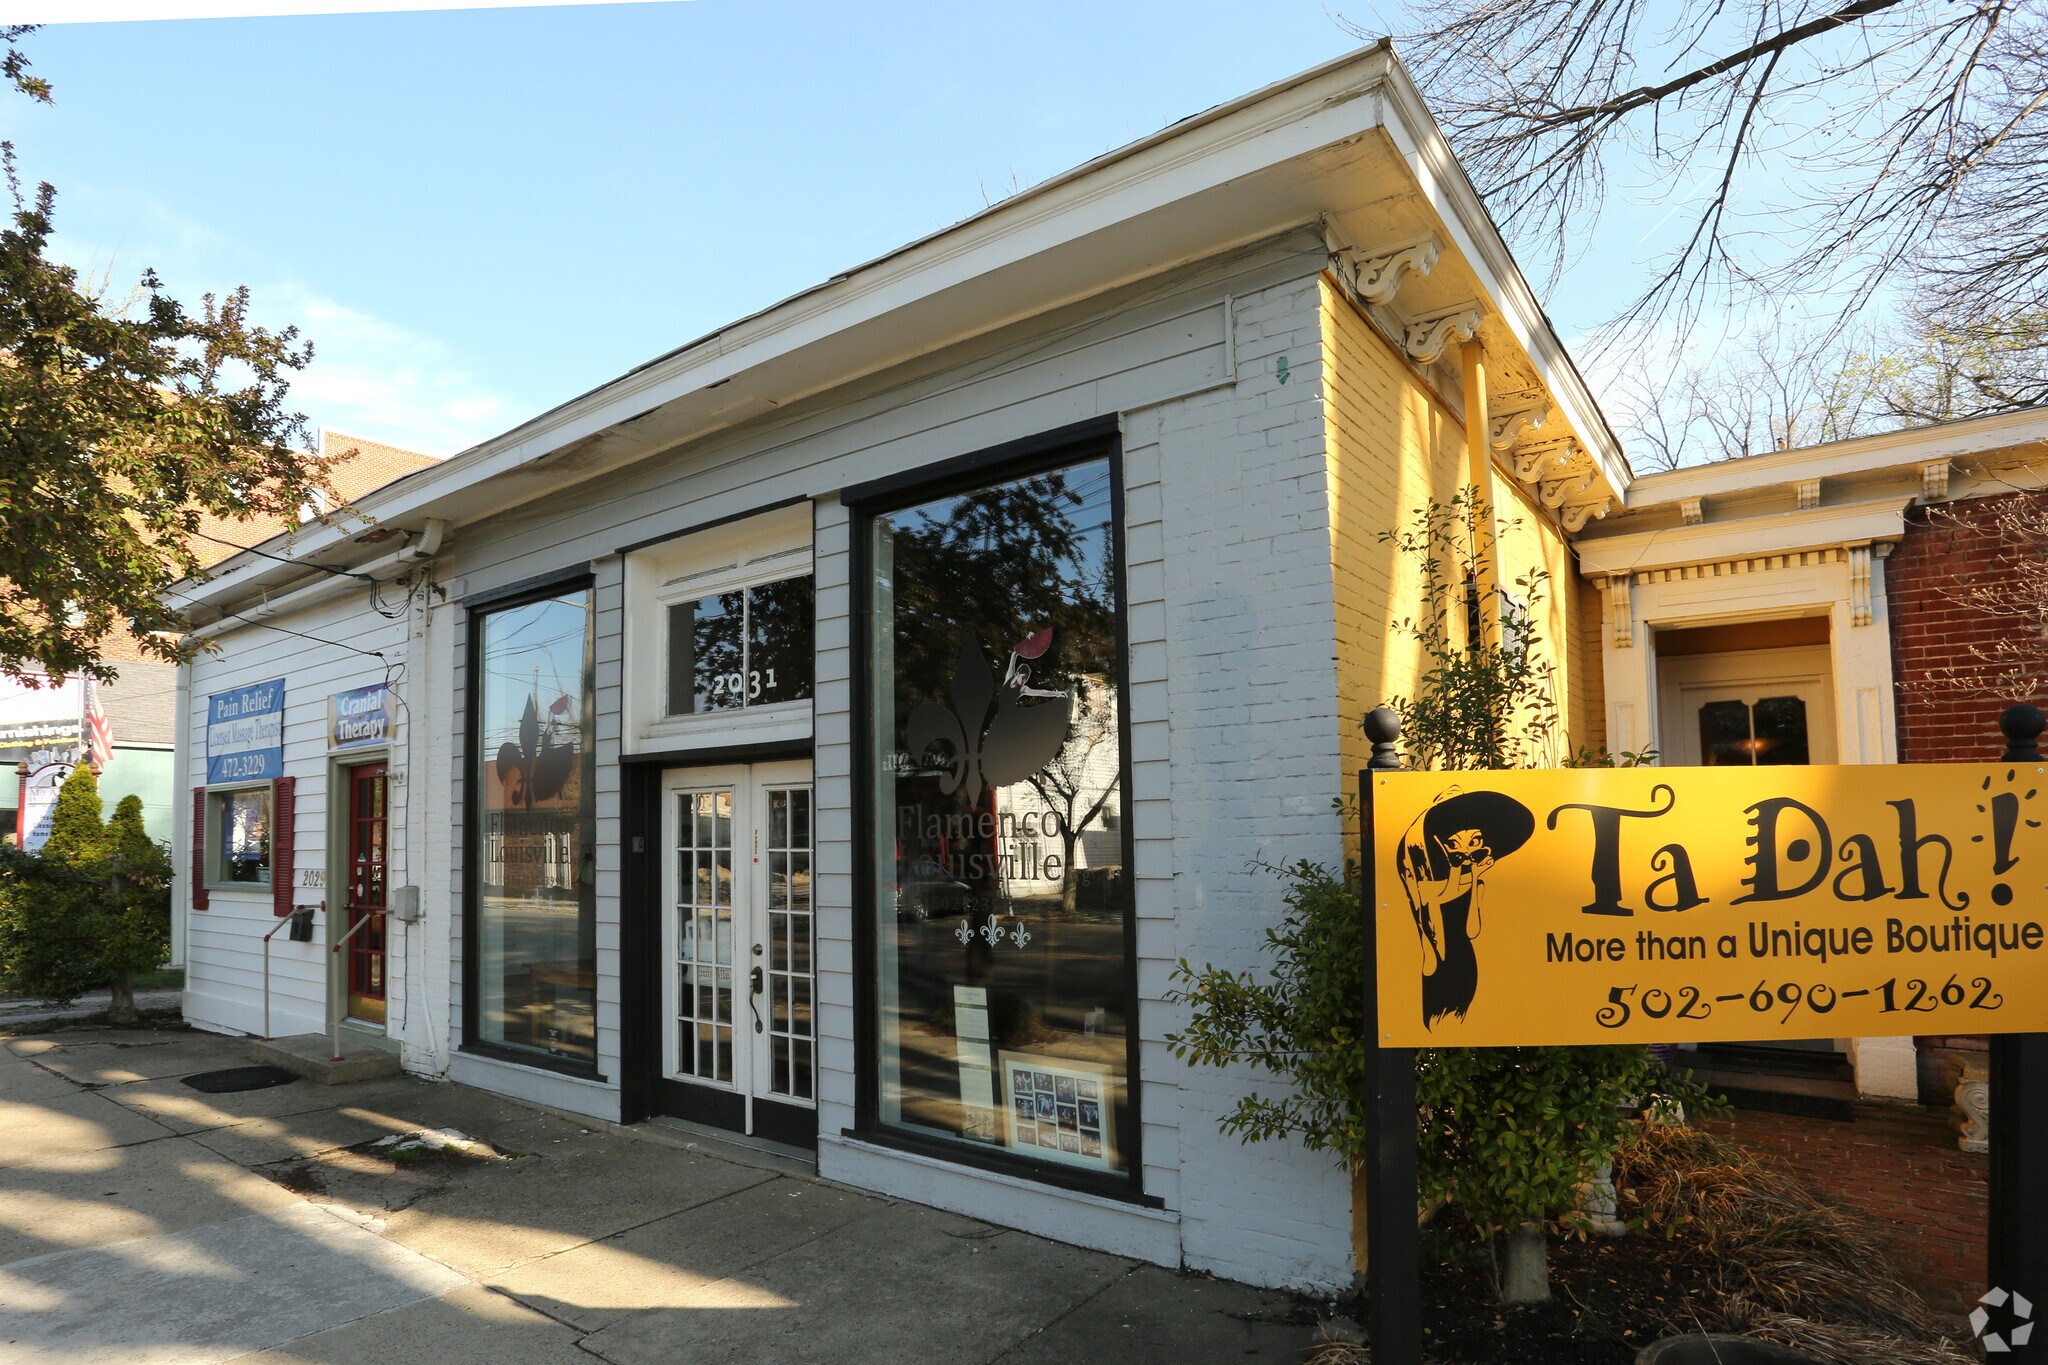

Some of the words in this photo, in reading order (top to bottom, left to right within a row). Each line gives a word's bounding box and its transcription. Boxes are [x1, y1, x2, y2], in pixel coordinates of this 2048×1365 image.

[713, 668, 777, 699] 2031
[217, 698, 239, 719] Pain
[241, 688, 274, 714] Relief
[341, 690, 382, 716] Cranial
[209, 724, 231, 748] Licensed
[231, 722, 254, 749] Massage
[255, 716, 282, 746] Therapist
[338, 718, 385, 740] Therapy
[222, 754, 265, 777] 472-3229
[897, 804, 1062, 840] Flamenco
[489, 838, 570, 864] Louisville
[1547, 784, 1710, 917] Ta
[1729, 791, 2020, 911] Dah!
[302, 870, 326, 887] 2029
[1546, 932, 1626, 963] More
[1635, 930, 1706, 961] than
[1717, 935, 1737, 958] a
[1748, 920, 1873, 964] Unique
[1886, 915, 2044, 959] Boutique
[1595, 973, 2004, 1029] 502-690-1262
